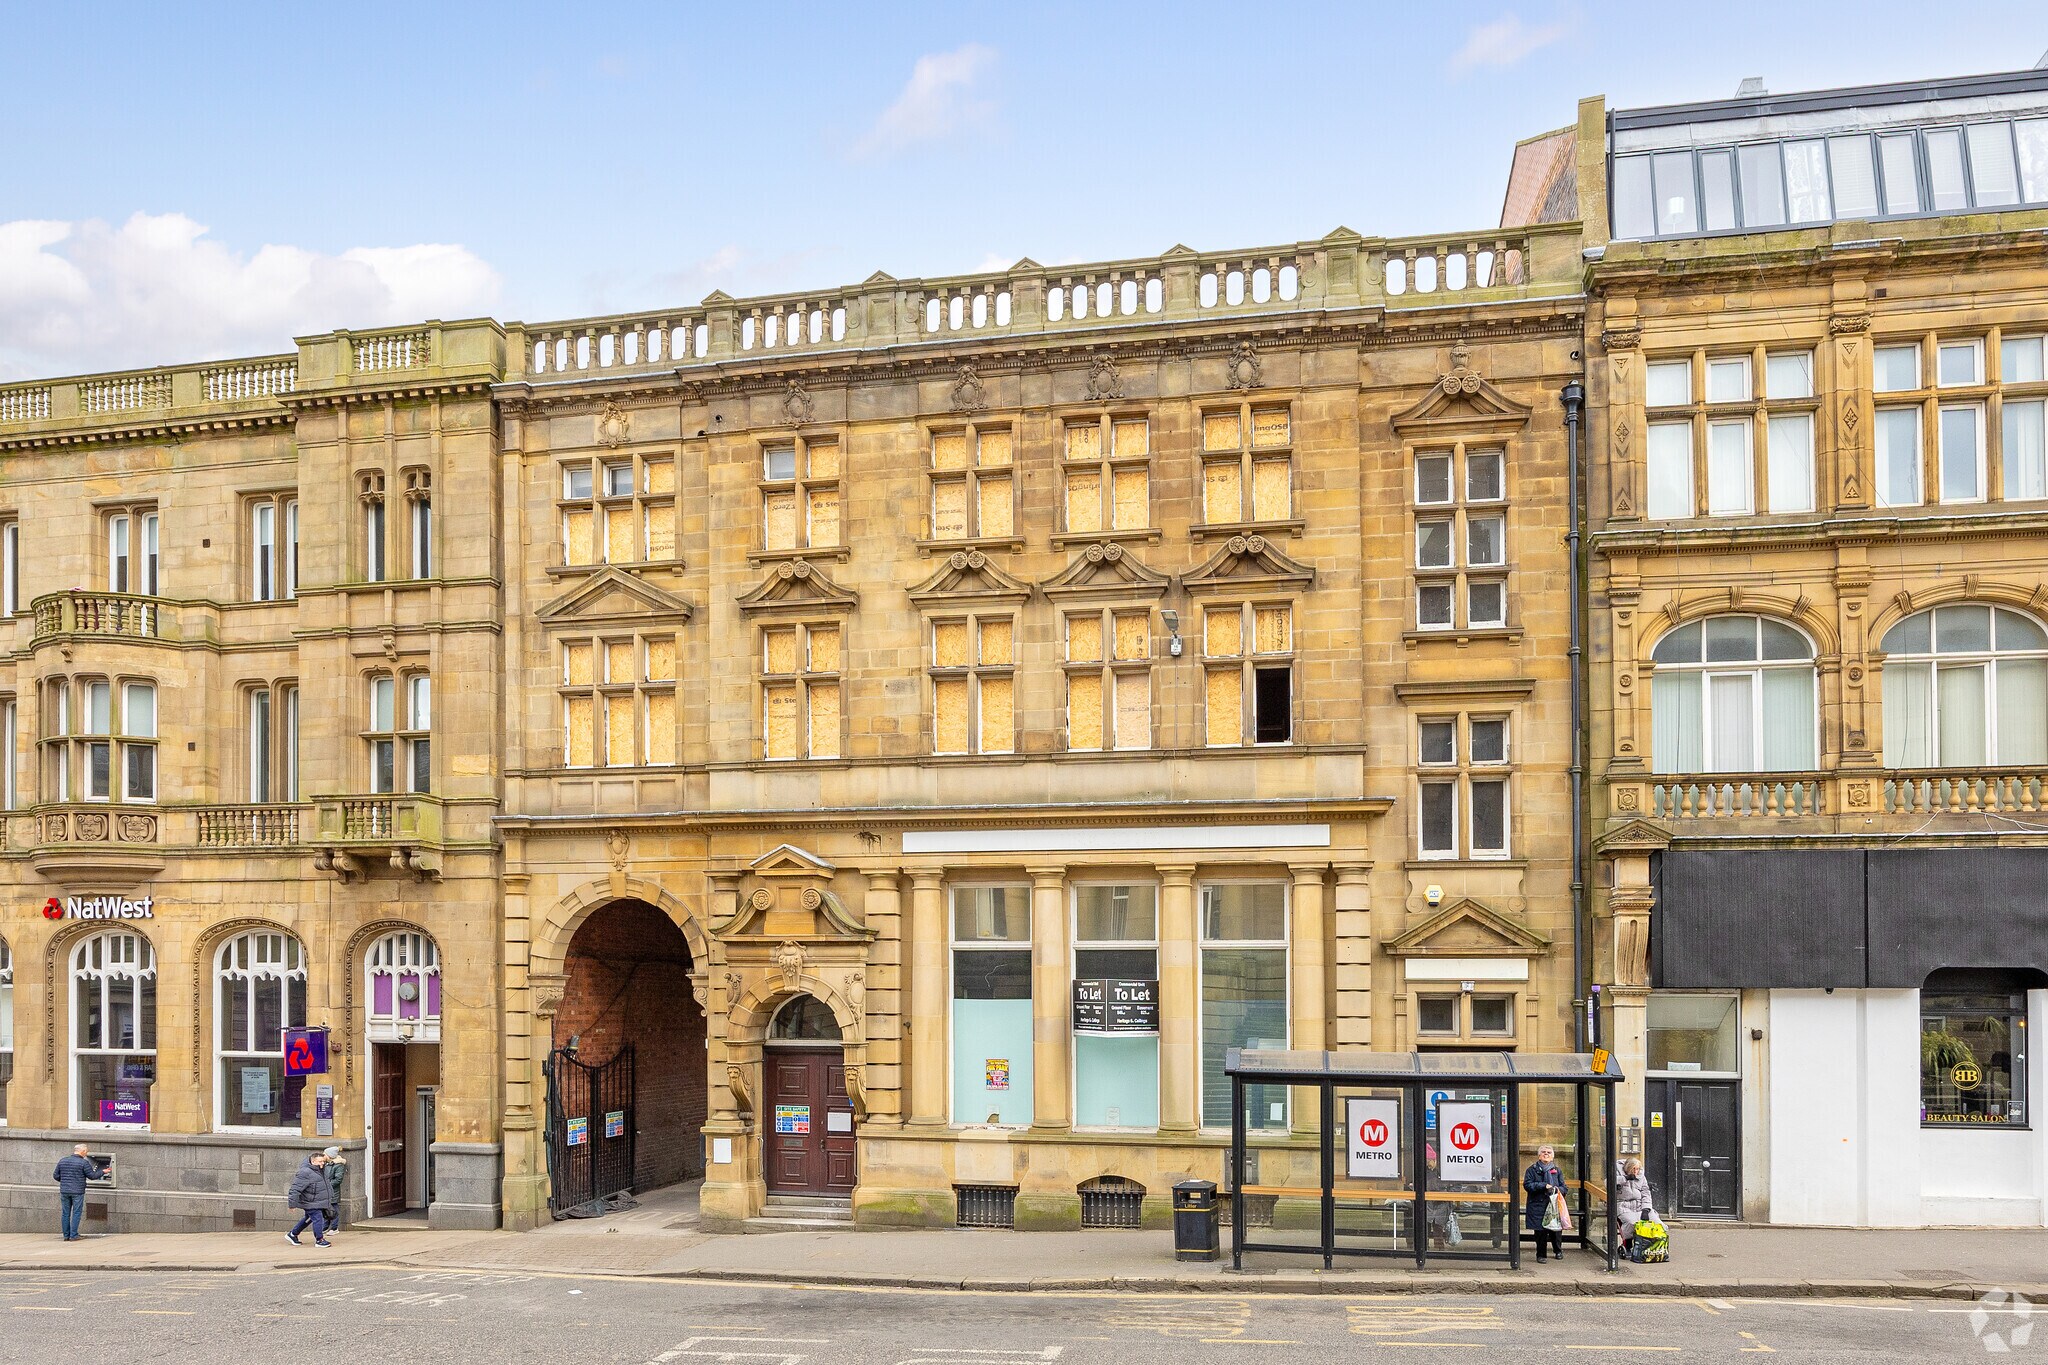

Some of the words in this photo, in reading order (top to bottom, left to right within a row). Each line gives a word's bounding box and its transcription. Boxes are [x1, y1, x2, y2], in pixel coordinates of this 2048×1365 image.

[67, 895, 153, 919] NatWest
[1078, 987, 1088, 1000] To
[1089, 987, 1101, 1000] Let
[1114, 987, 1128, 1000] To
[1131, 988, 1150, 1001] Let
[114, 1102, 141, 1111] NatWest
[1927, 1114, 1968, 1122] BEAUTY
[1970, 1114, 2006, 1122] SALON
[1364, 1125, 1384, 1141] M
[1454, 1128, 1475, 1144] M
[1356, 1152, 1392, 1160] METRO
[1446, 1155, 1484, 1164] METRO
